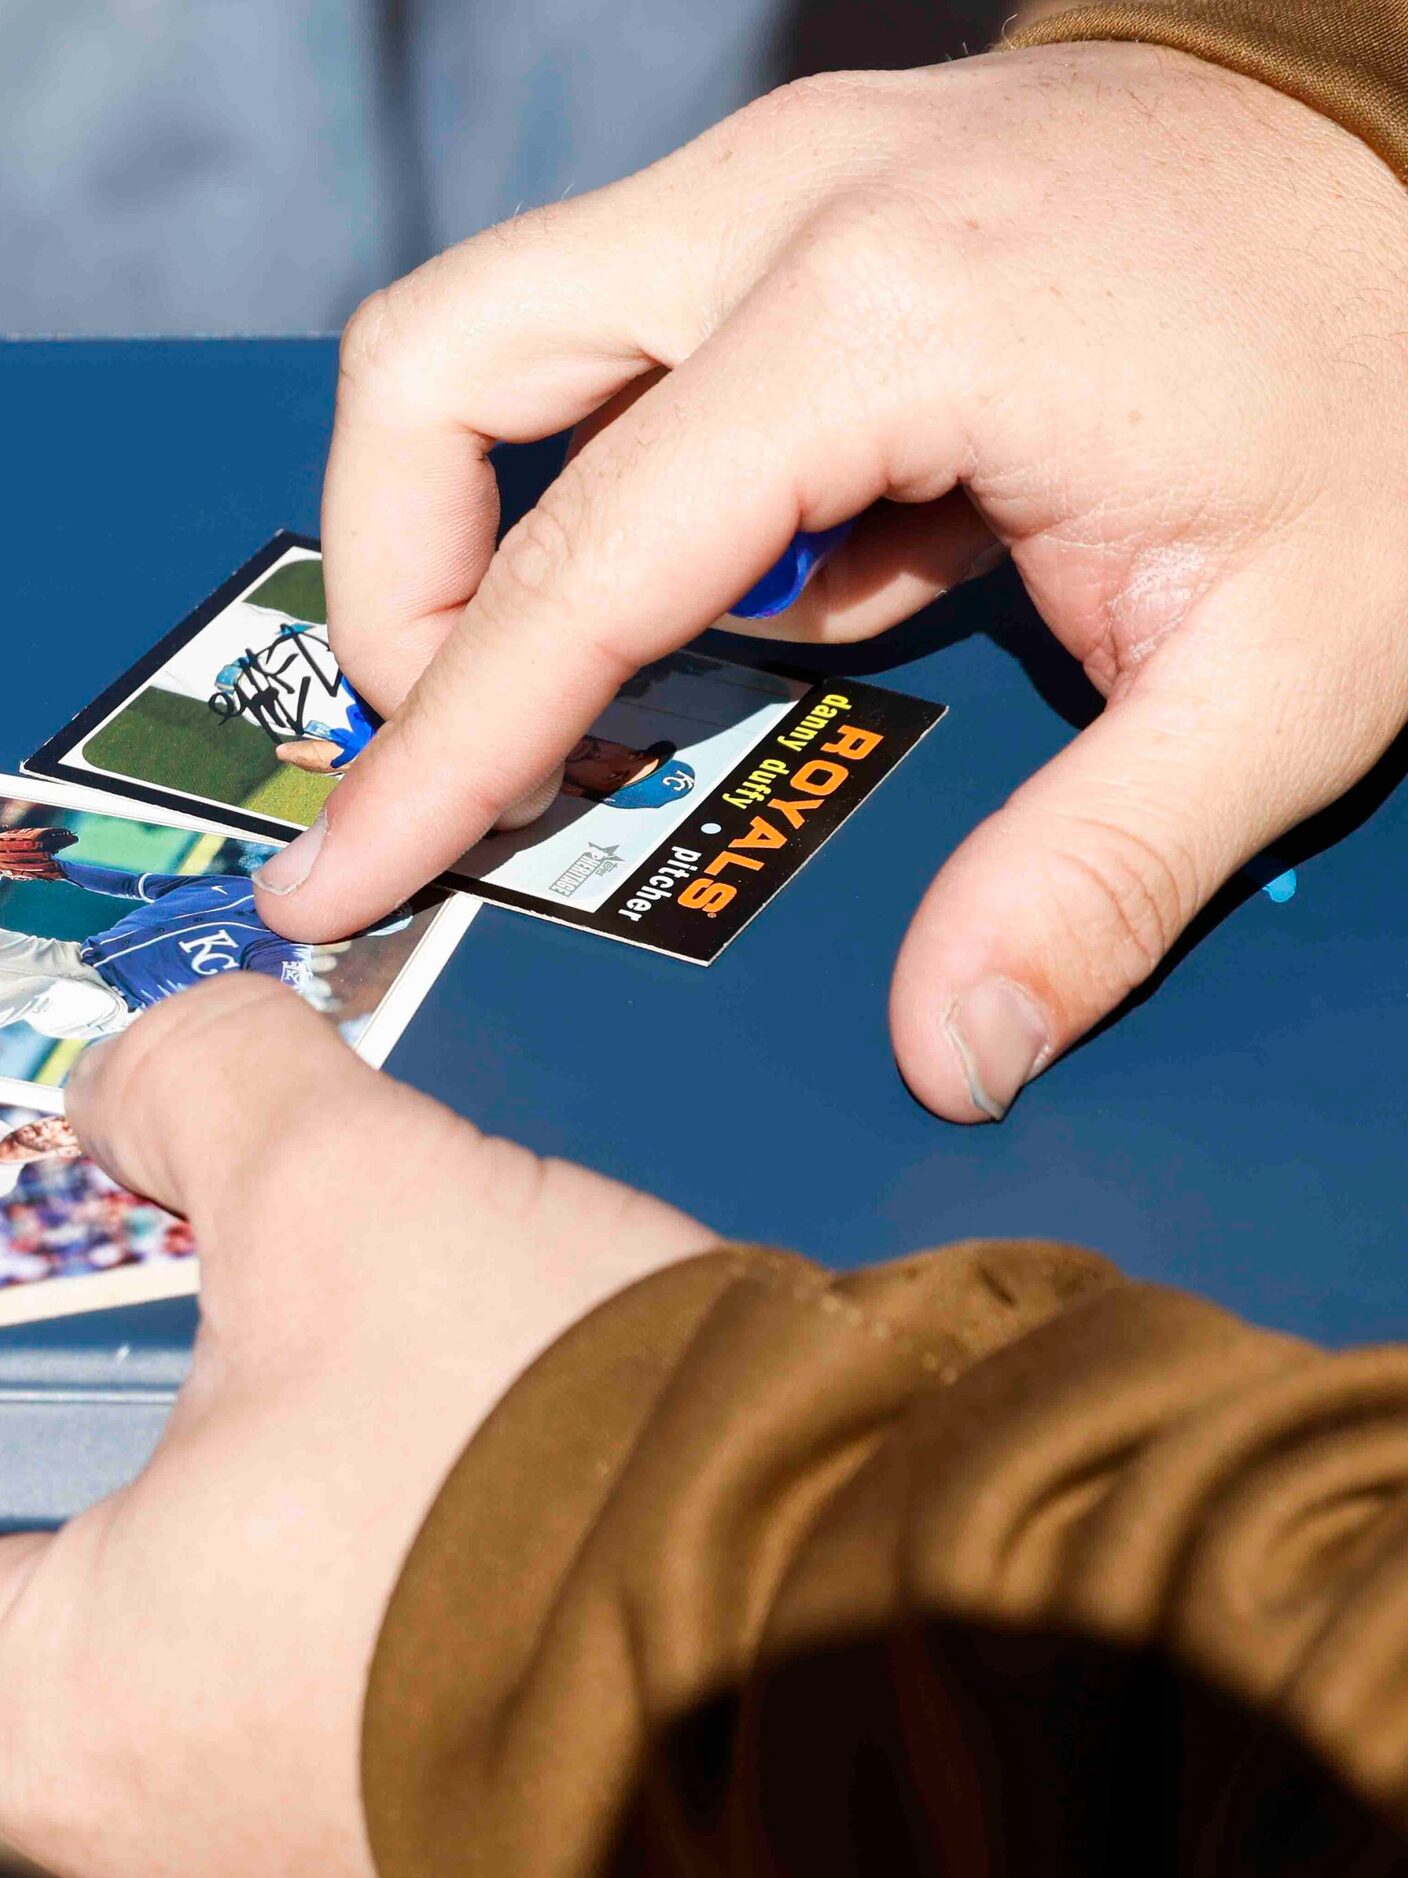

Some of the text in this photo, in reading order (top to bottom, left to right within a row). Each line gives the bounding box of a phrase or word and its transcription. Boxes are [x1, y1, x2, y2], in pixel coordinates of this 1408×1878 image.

[618, 692, 851, 922] danny duffy pitcher
[676, 723, 885, 918] ROYALS
[179, 929, 240, 977] KC
